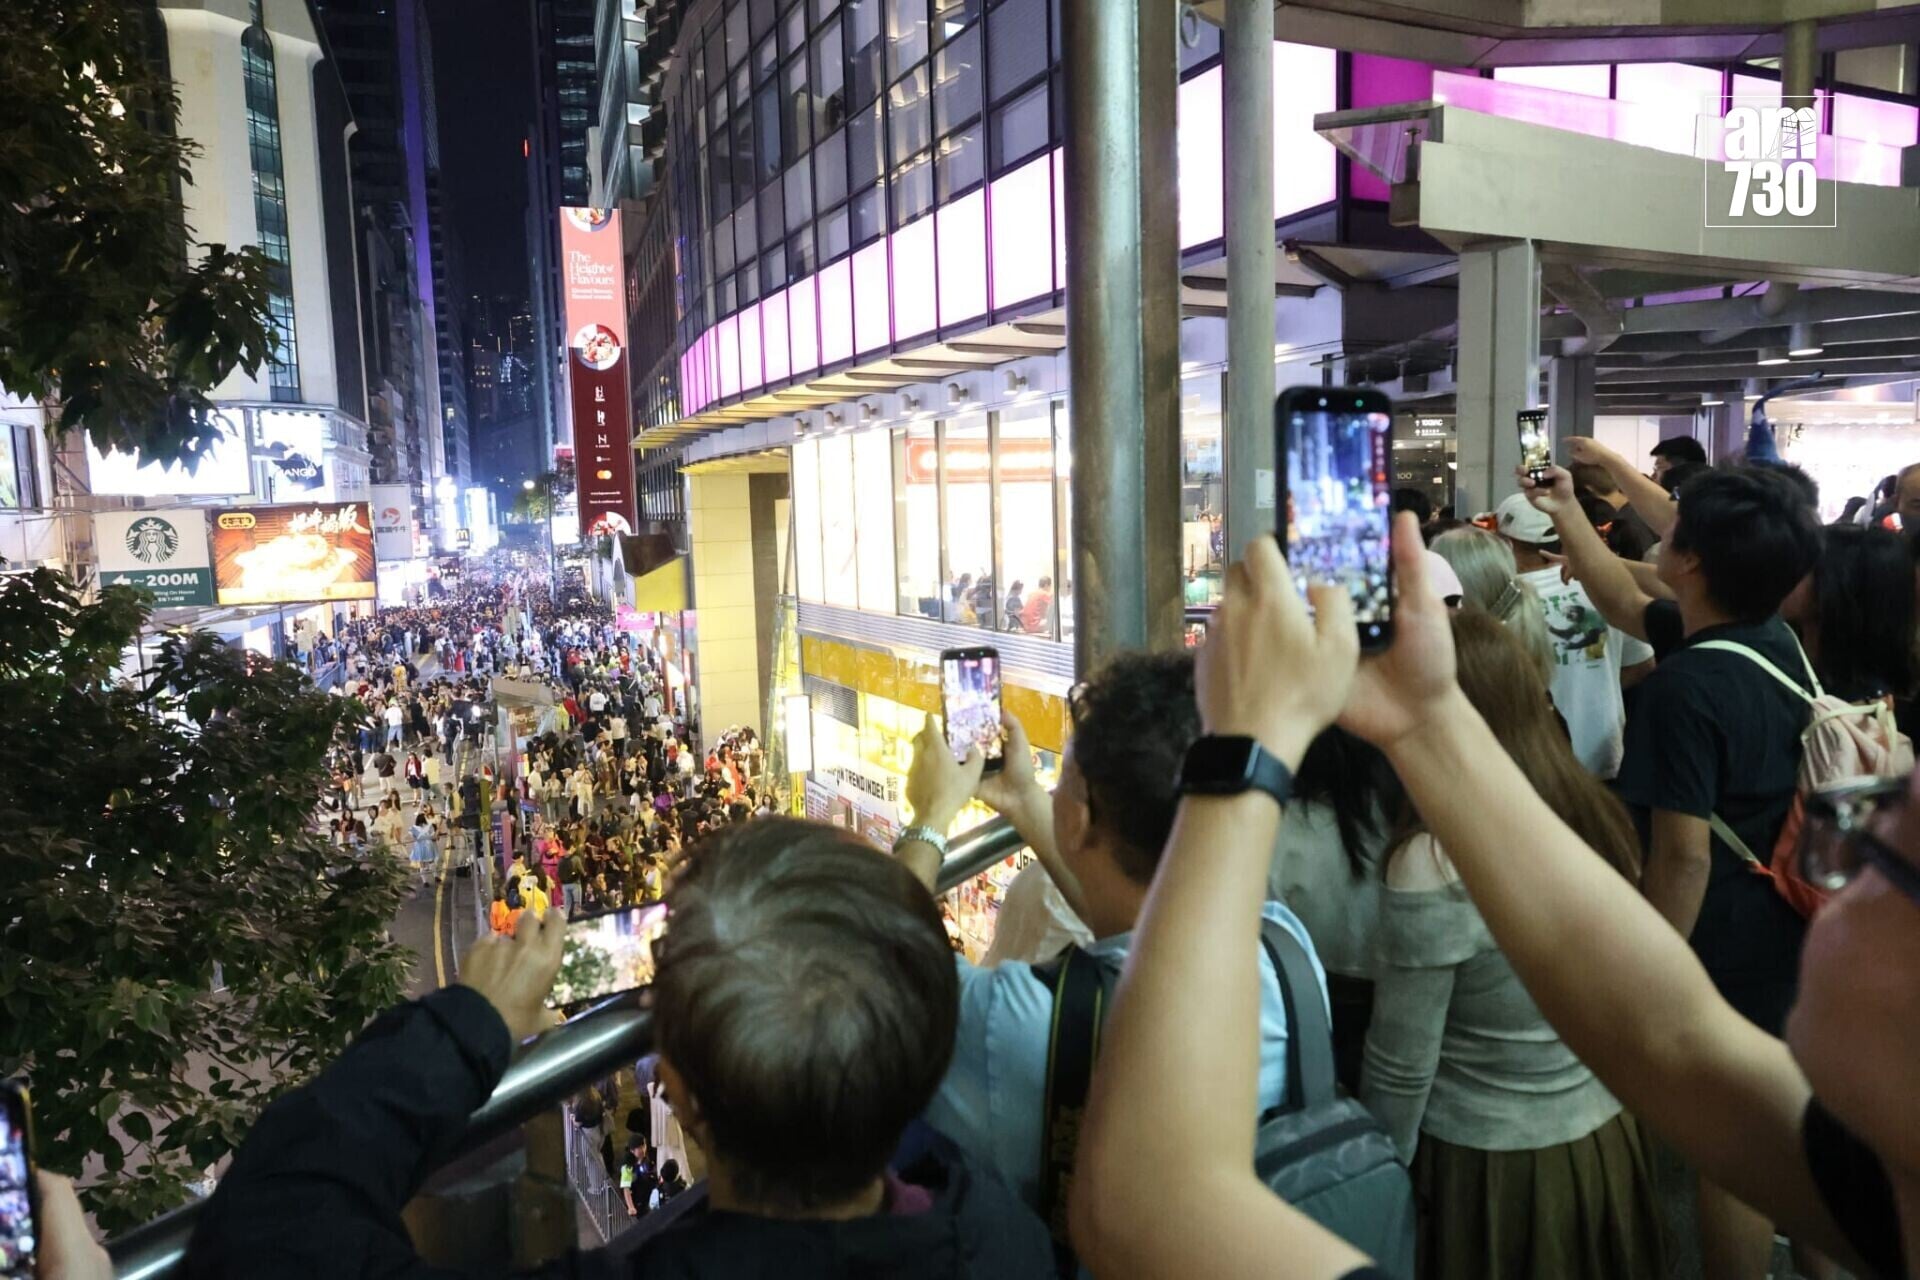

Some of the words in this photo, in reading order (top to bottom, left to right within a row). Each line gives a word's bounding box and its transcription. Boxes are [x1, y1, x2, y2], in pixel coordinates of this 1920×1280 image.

[569, 251, 592, 262] The
[569, 263, 605, 275] Height
[570, 276, 615, 285] Flavours
[146, 573, 199, 586] 200M
